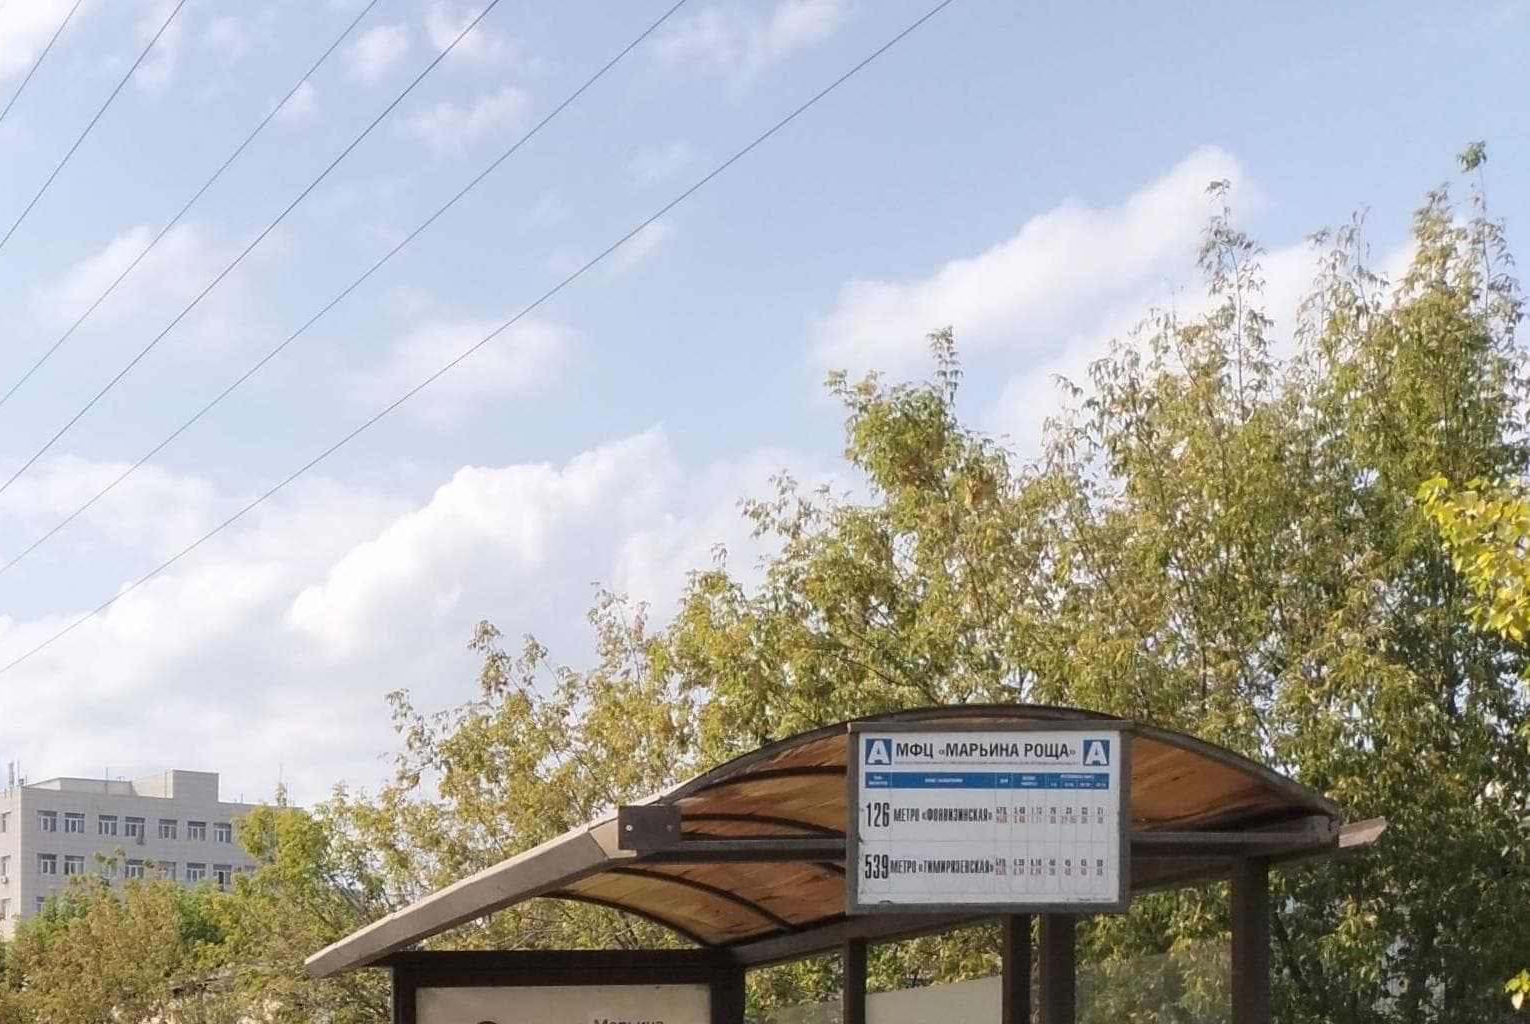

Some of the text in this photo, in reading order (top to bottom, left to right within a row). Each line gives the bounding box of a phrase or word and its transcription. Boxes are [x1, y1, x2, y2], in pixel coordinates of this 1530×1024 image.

[896, 743, 1076, 759] МФЦ «МАРЬИНА РОЩА»
[866, 802, 890, 827] 126
[893, 808, 920, 822] МЕТРО
[864, 854, 889, 879] 539
[890, 860, 917, 874] МЕТРО
